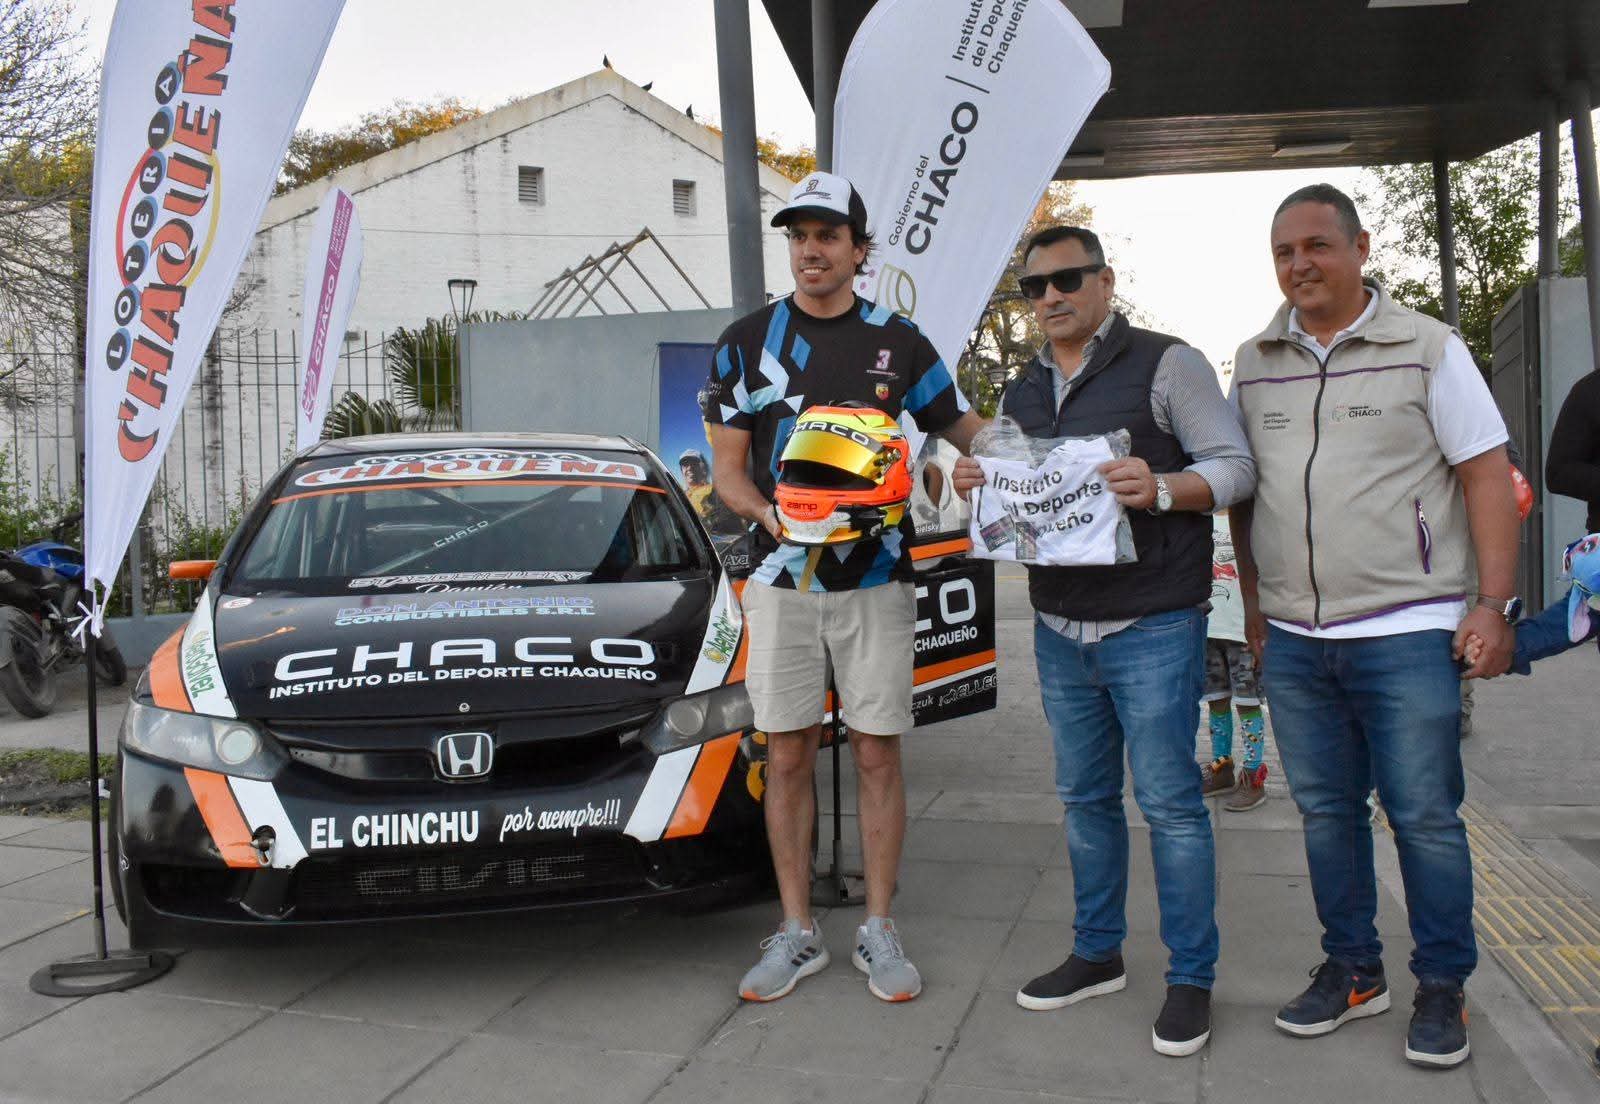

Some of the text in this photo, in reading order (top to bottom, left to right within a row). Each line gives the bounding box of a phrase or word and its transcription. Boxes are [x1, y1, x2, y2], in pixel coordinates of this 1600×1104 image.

[952, 0, 984, 61] Institut
[988, 0, 1030, 74] Chaqueñ
[972, 40, 989, 67] del
[905, 101, 979, 255] CHACO
[107, 66, 177, 367] LOTERIA
[889, 154, 930, 246] Gobierno del
[118, 0, 236, 463] CHAQUEÑA
[314, 275, 335, 365] CHACO
[875, 349, 891, 370] 3
[1348, 409, 1382, 418] CHACO
[993, 469, 1062, 496] Instituto
[1024, 482, 1102, 516] Deporte
[786, 501, 818, 512] zamp
[433, 520, 489, 549] CHACO
[334, 607, 529, 627] COMBUSTIBLES
[336, 597, 594, 619] DON ANTONIO
[913, 625, 978, 653] CHAQUEÑO
[274, 636, 655, 682] CHACO
[269, 665, 658, 699] INSTITUTO DEL DEPORTE CHAQUEÑO
[310, 798, 621, 849] EL CHINCHU por siempre!!!
[354, 854, 585, 895] CIVIC
